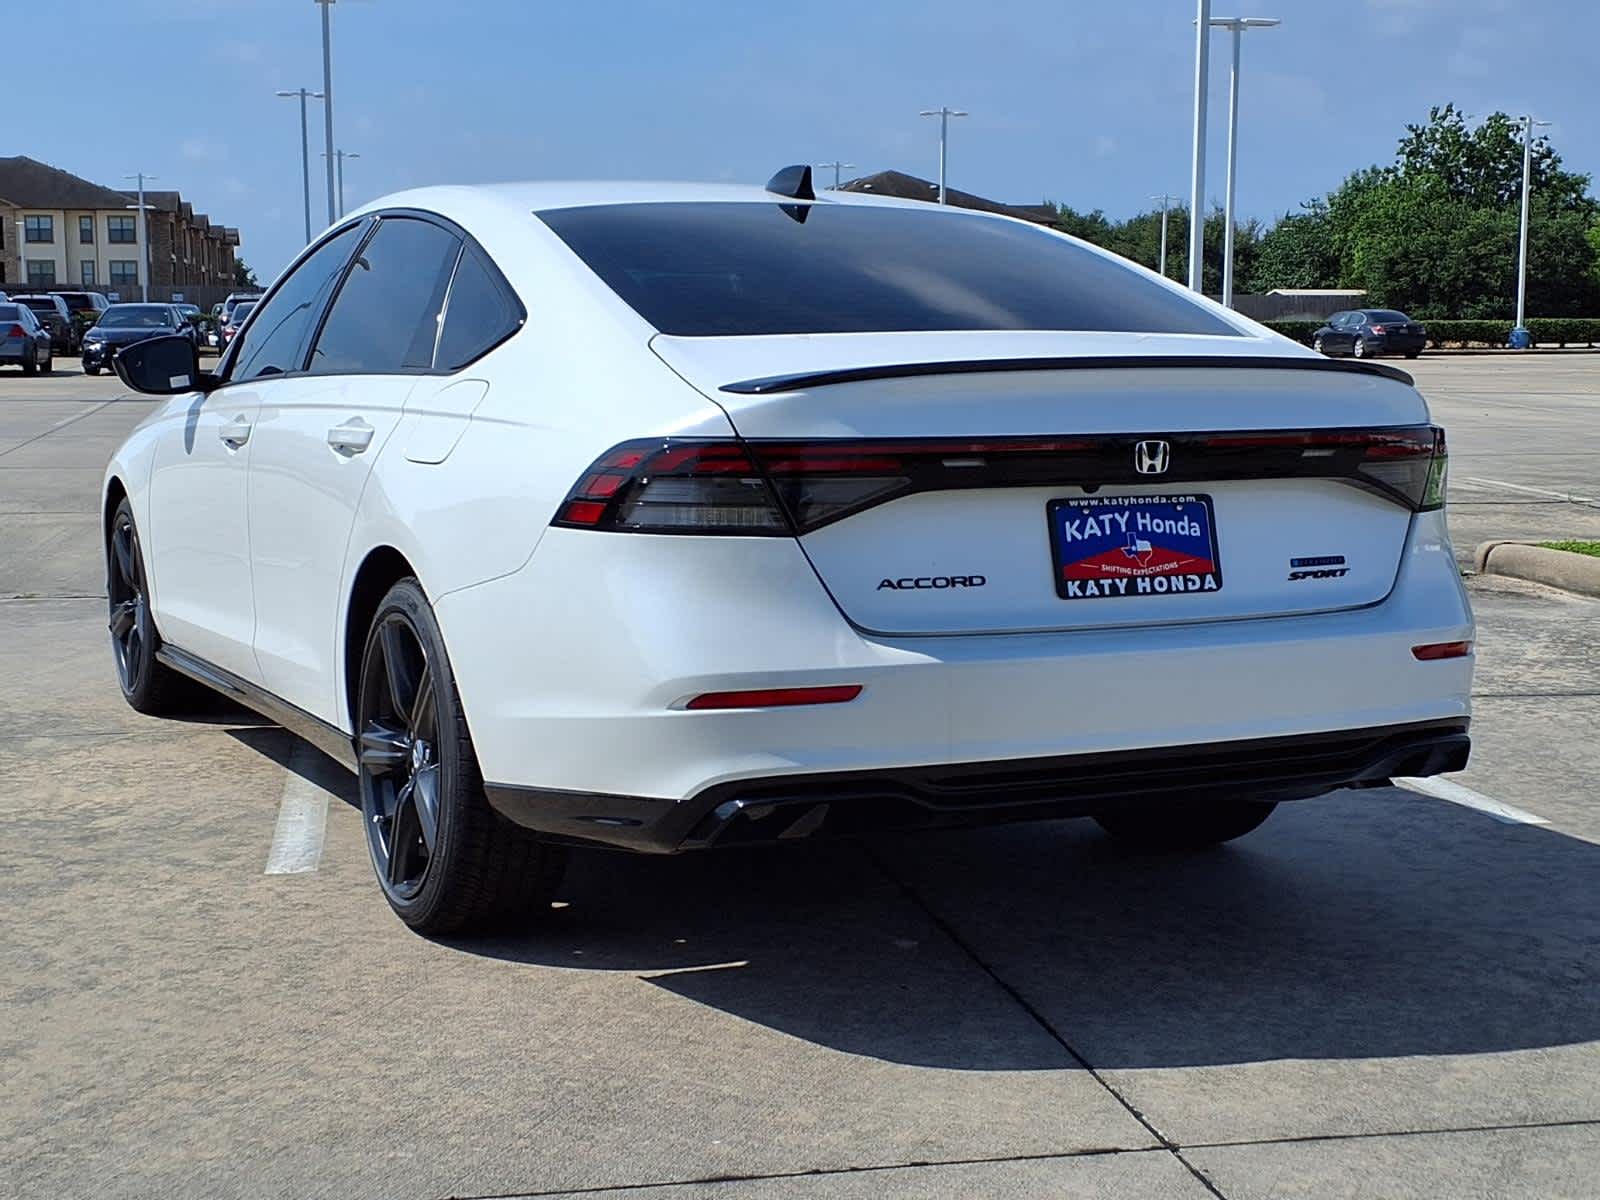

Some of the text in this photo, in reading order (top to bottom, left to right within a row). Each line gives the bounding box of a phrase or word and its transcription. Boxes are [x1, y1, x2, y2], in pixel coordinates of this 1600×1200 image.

[1068, 496, 1196, 506] www.katyhonda.com
[1065, 510, 1201, 542] KATY Honda
[1101, 564, 1132, 575] SHIFTING
[1287, 567, 1351, 581] SPORT
[876, 575, 986, 591] ACCORD
[1066, 573, 1217, 598] KATY HONDA
